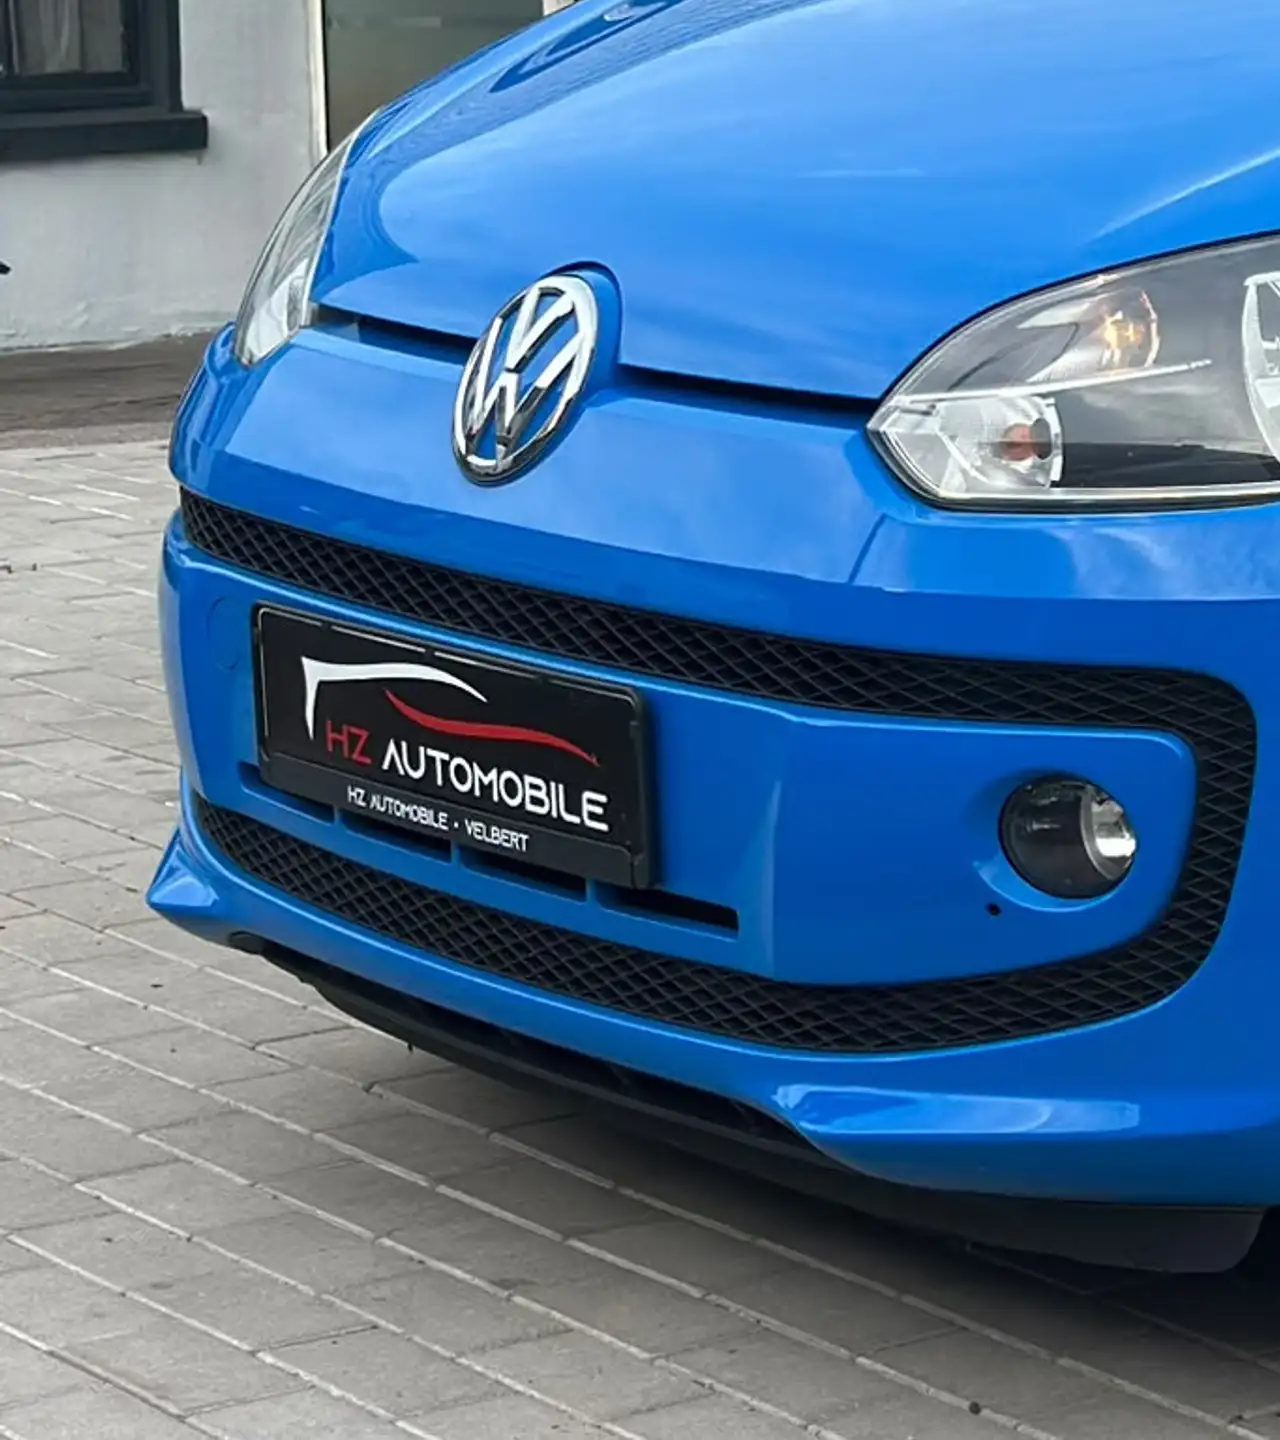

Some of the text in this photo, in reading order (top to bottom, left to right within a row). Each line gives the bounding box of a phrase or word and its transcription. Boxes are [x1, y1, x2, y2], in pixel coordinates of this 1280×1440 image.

[325, 720, 610, 832] HZ AUTOMOBILE
[347, 785, 530, 852] HZ AUTOMOBILE VELBERT
